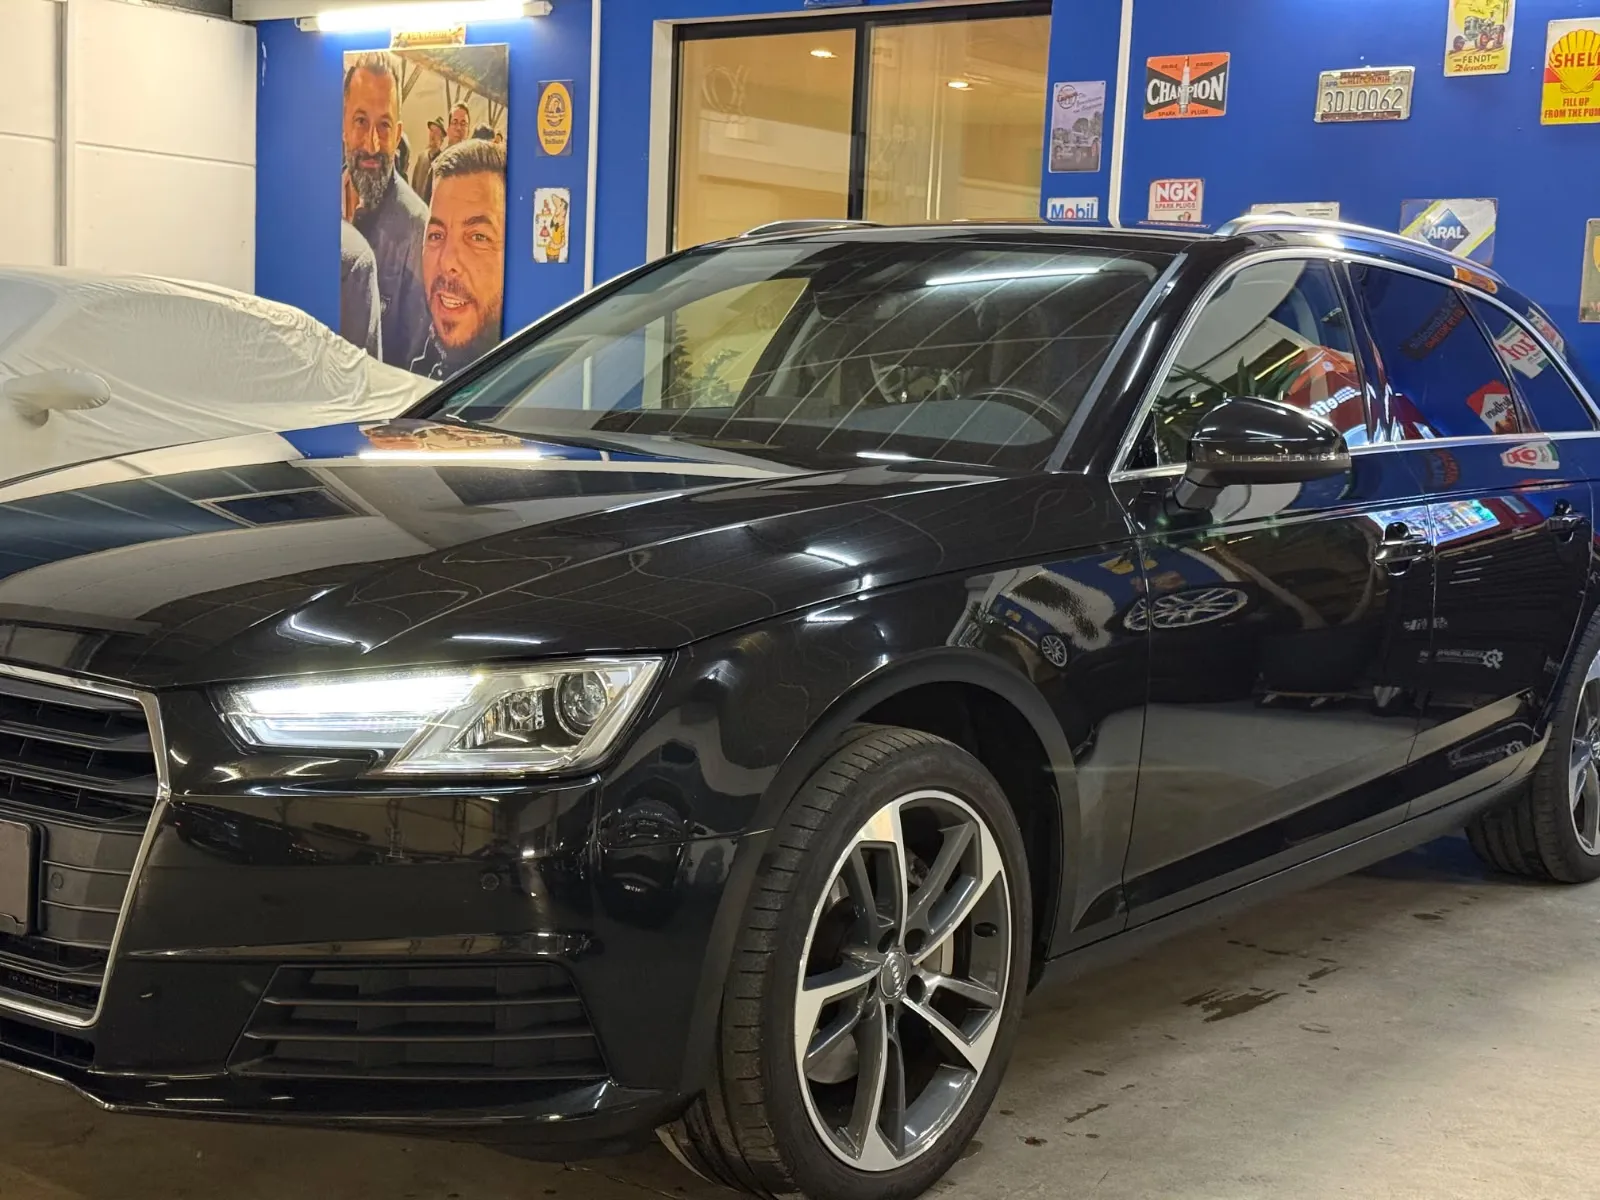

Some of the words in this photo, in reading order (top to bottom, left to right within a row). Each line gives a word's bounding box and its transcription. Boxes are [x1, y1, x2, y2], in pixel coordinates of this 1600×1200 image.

[1463, 54, 1491, 63] FENDT
[1563, 97, 1577, 107] FILL
[1544, 108, 1566, 118] FROM
[1568, 108, 1582, 117] THE
[1156, 182, 1197, 202] NGK
[1051, 203, 1095, 220] Mobil
[1427, 225, 1465, 239] ARAL
